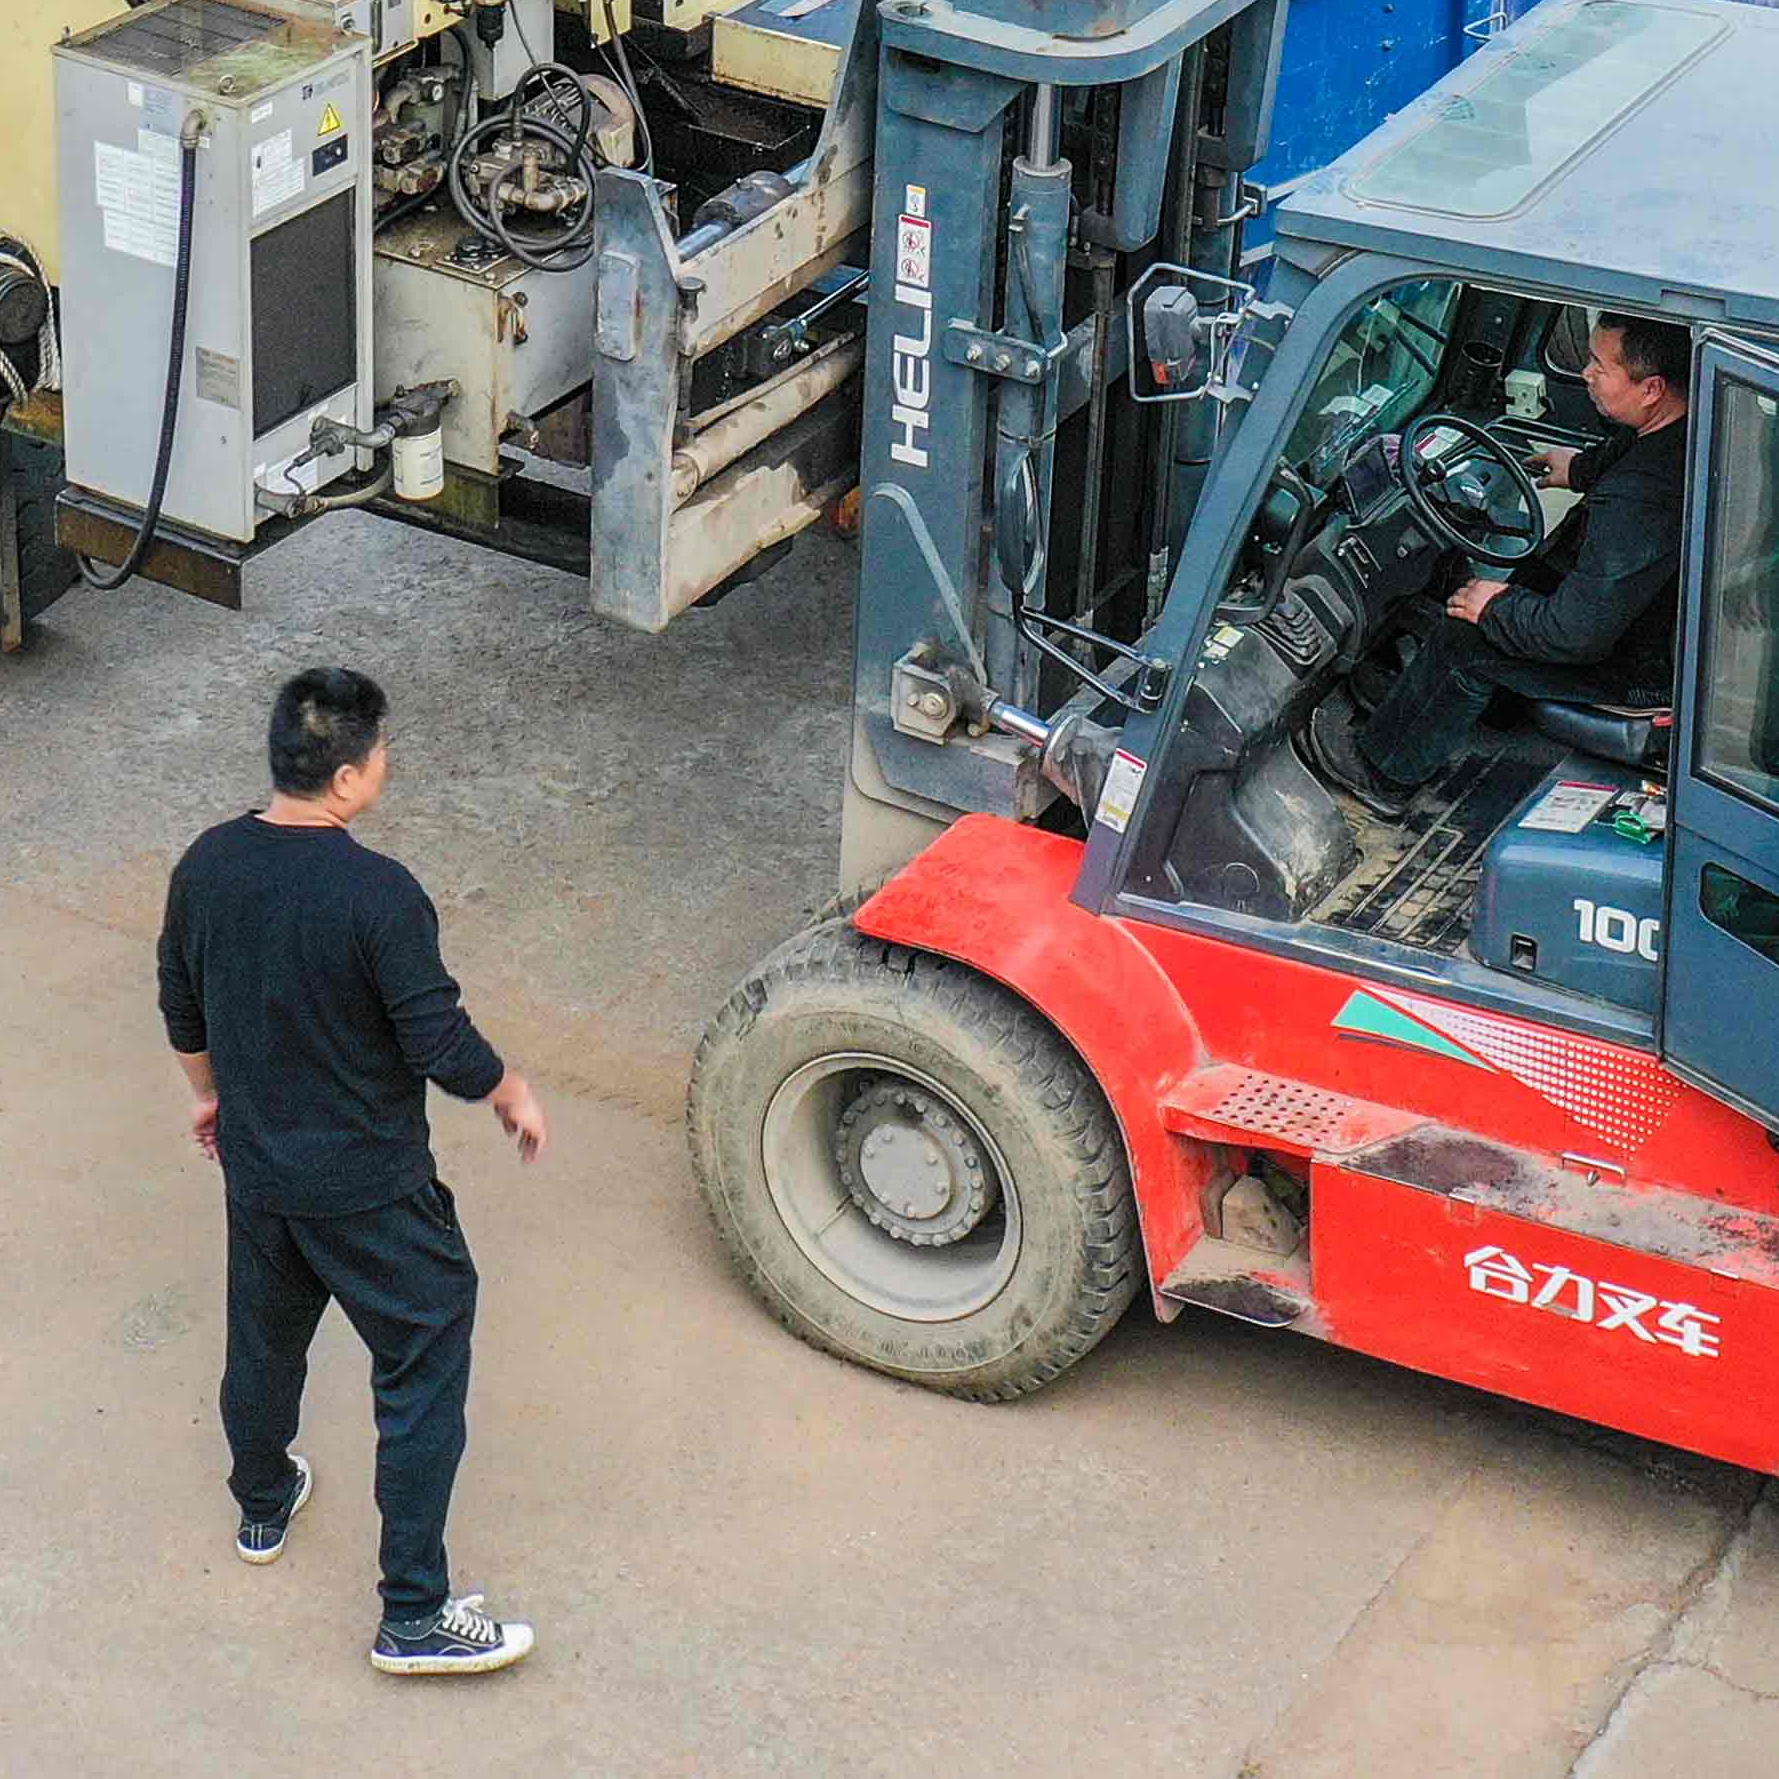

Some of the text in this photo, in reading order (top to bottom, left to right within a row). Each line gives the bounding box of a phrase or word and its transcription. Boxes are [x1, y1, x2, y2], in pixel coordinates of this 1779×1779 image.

[890, 283, 933, 469] HELI
[1464, 1245, 1721, 1357] 合力叉车
